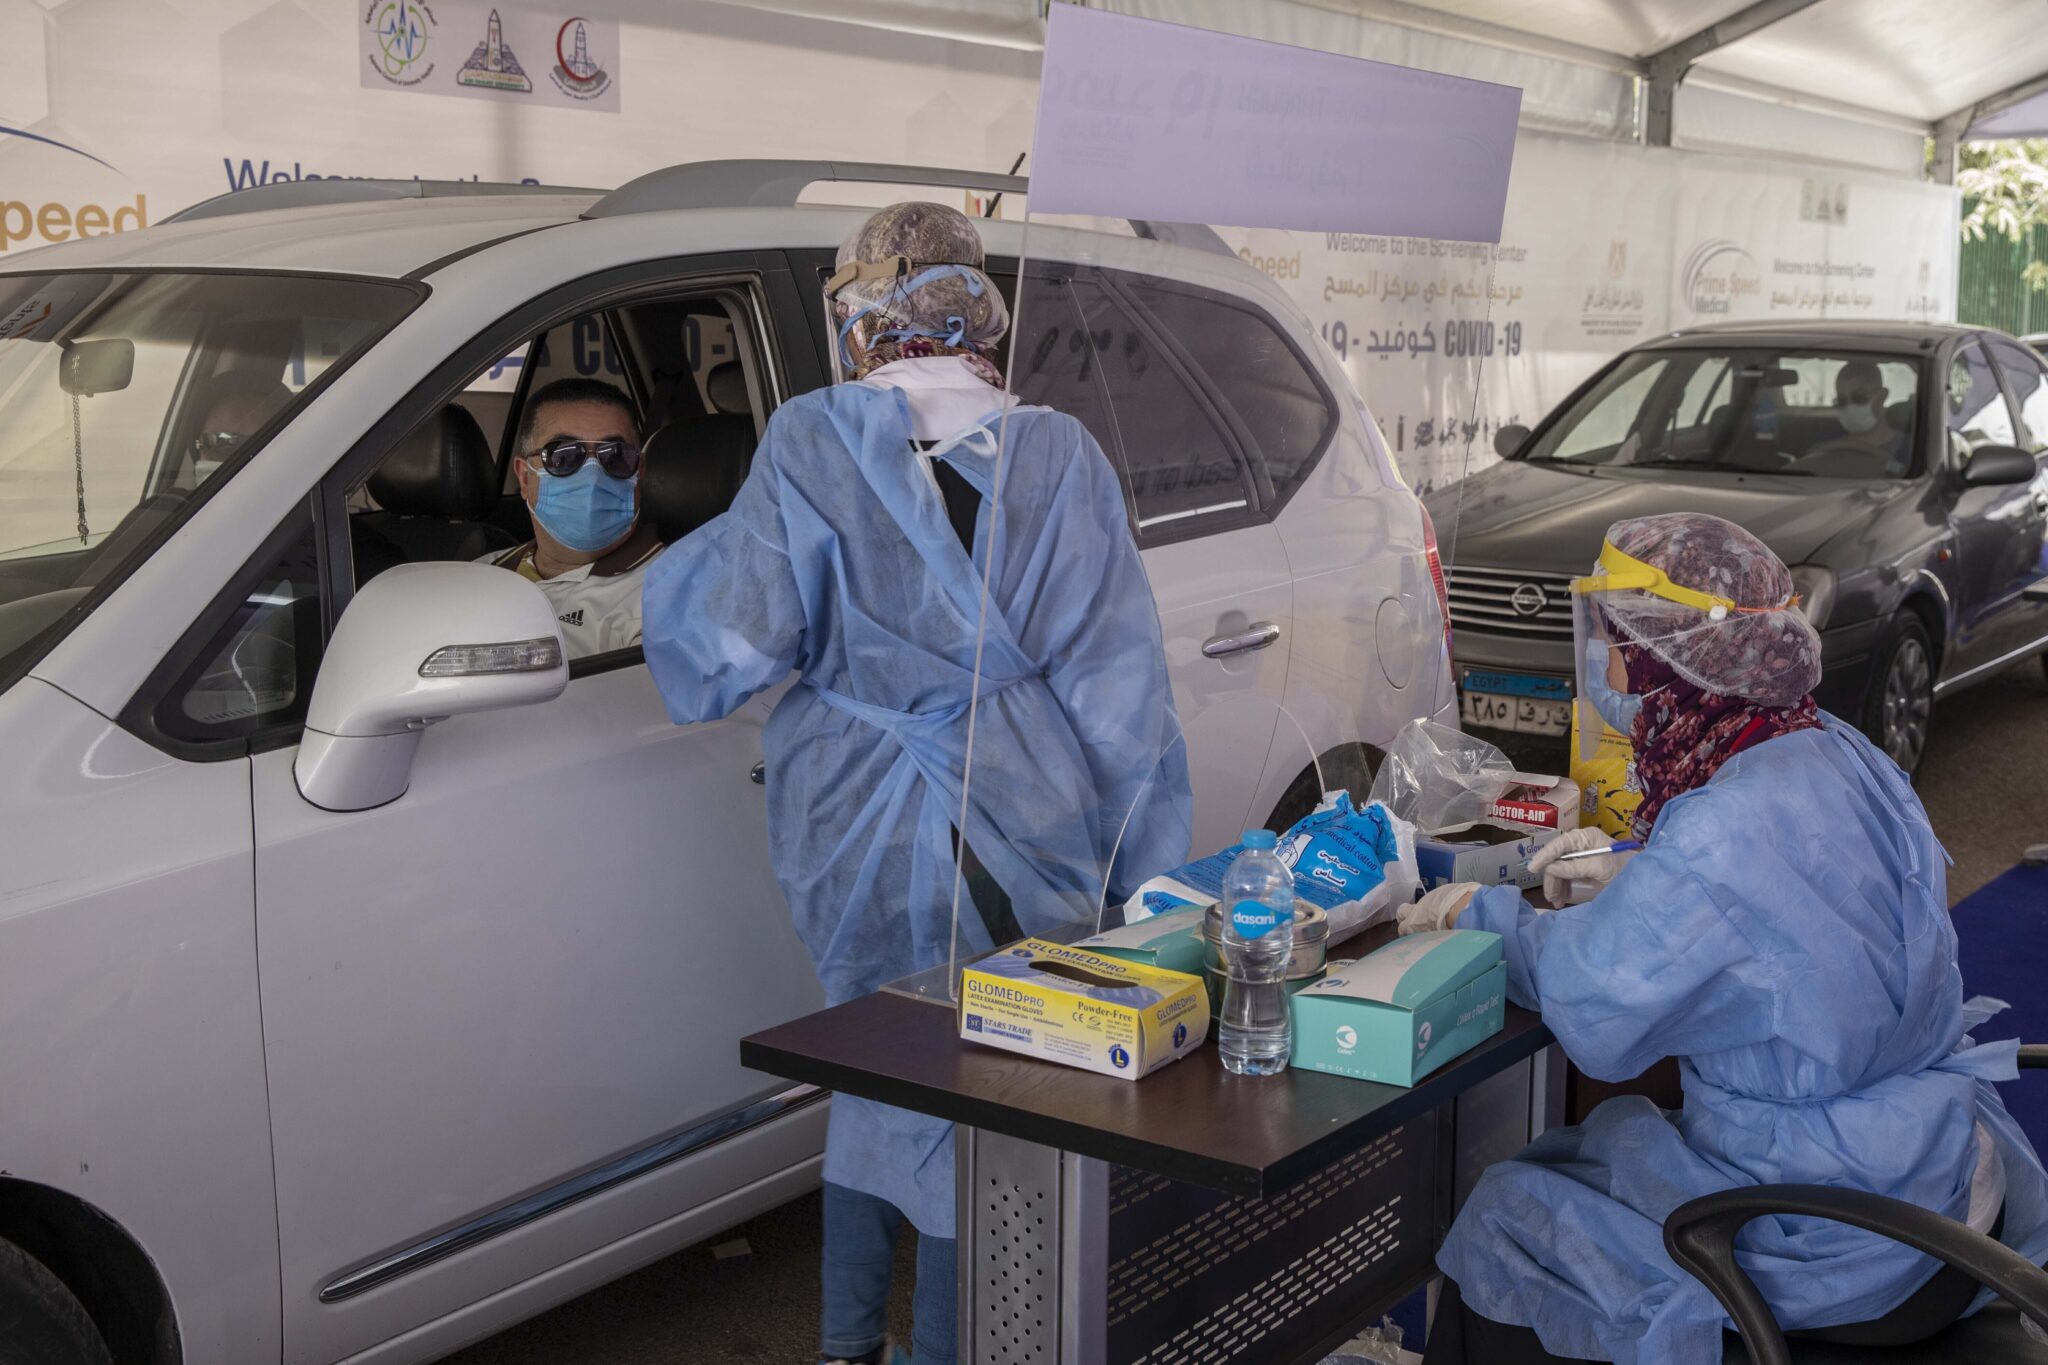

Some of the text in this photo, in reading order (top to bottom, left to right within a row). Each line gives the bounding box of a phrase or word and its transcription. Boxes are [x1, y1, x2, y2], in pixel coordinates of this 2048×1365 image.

[1472, 675, 1508, 689] EGYPT
[1327, 830, 1378, 872] medical cotton
[1233, 911, 1276, 925] dasani
[1026, 941, 1128, 973] GLOMEDPRO
[967, 979, 1045, 1008] GLOMEDPRO
[967, 992, 1044, 1016] LATEX EXAMINATION GLOVES
[1078, 1001, 1133, 1022] Powder-Free
[984, 1018, 1033, 1037] STARS TRADE
[1072, 1012, 1084, 1023] CE
[1115, 1049, 1124, 1064] L
